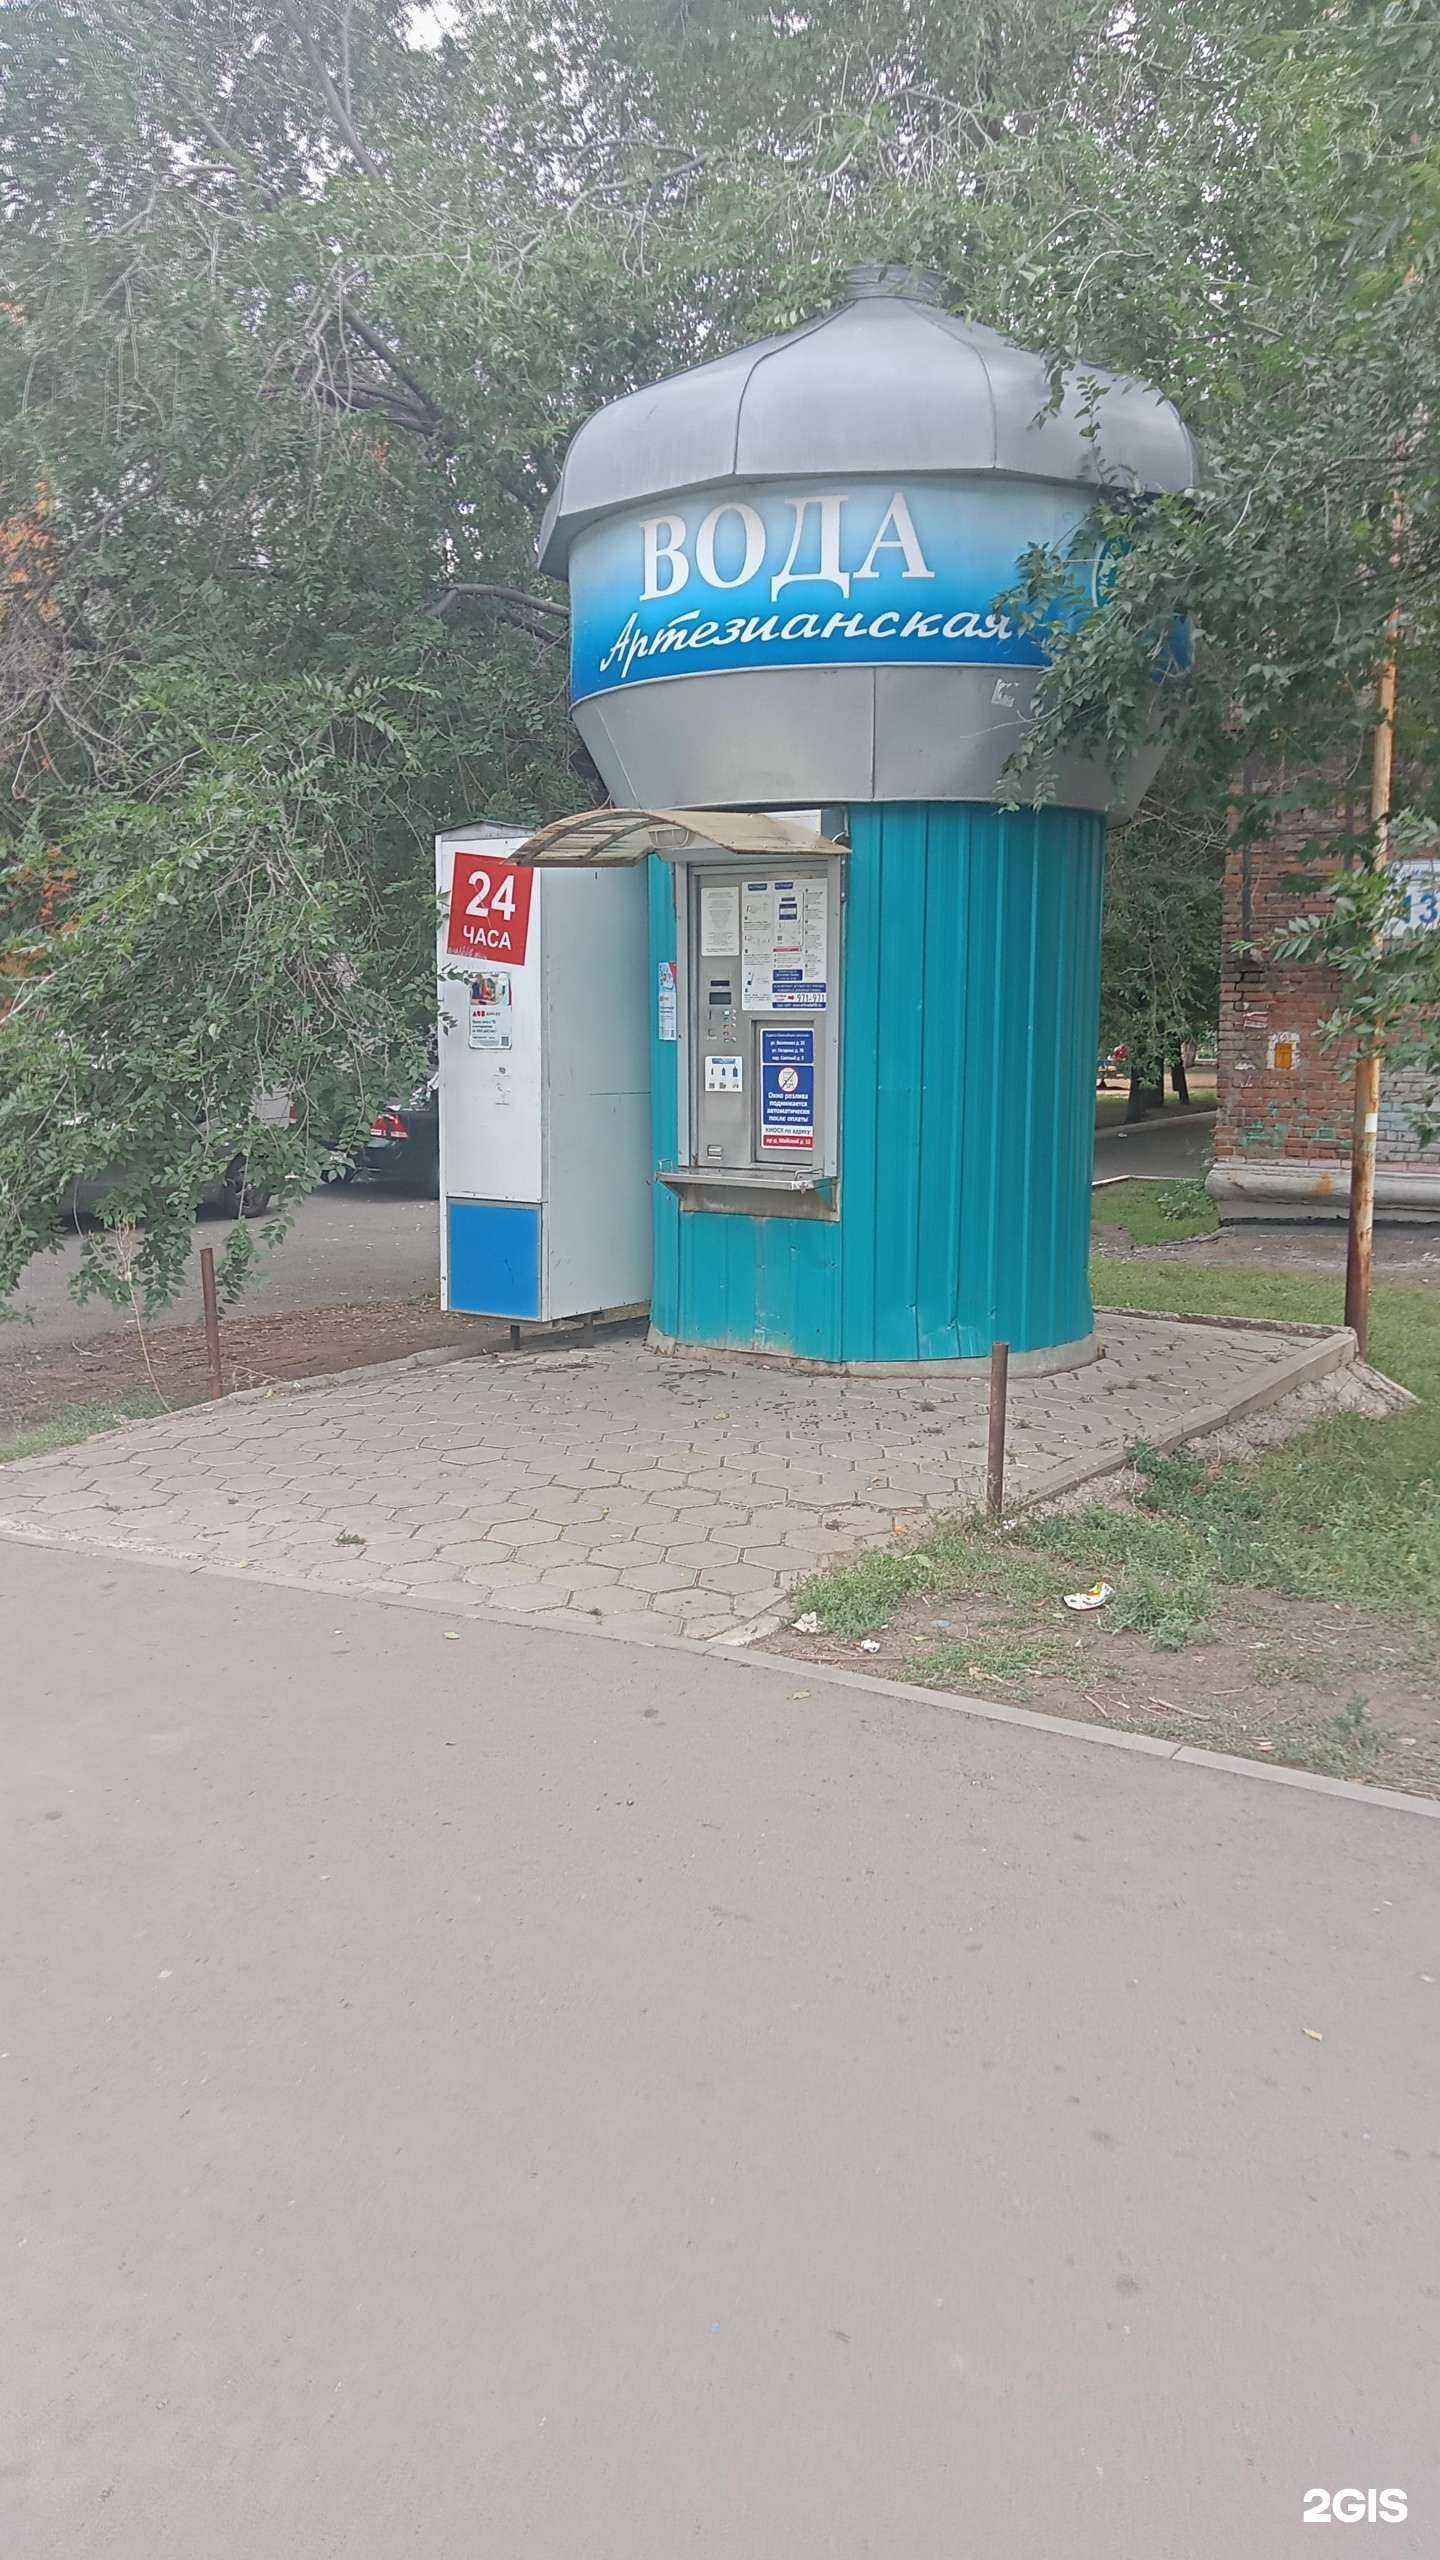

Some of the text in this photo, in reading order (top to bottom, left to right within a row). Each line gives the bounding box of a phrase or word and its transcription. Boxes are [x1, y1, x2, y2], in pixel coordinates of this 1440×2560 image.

[639, 491, 936, 602] ВОДА
[600, 609, 1014, 678] Артезианская
[465, 869, 516, 921] 24
[463, 924, 512, 951] ЧАСА
